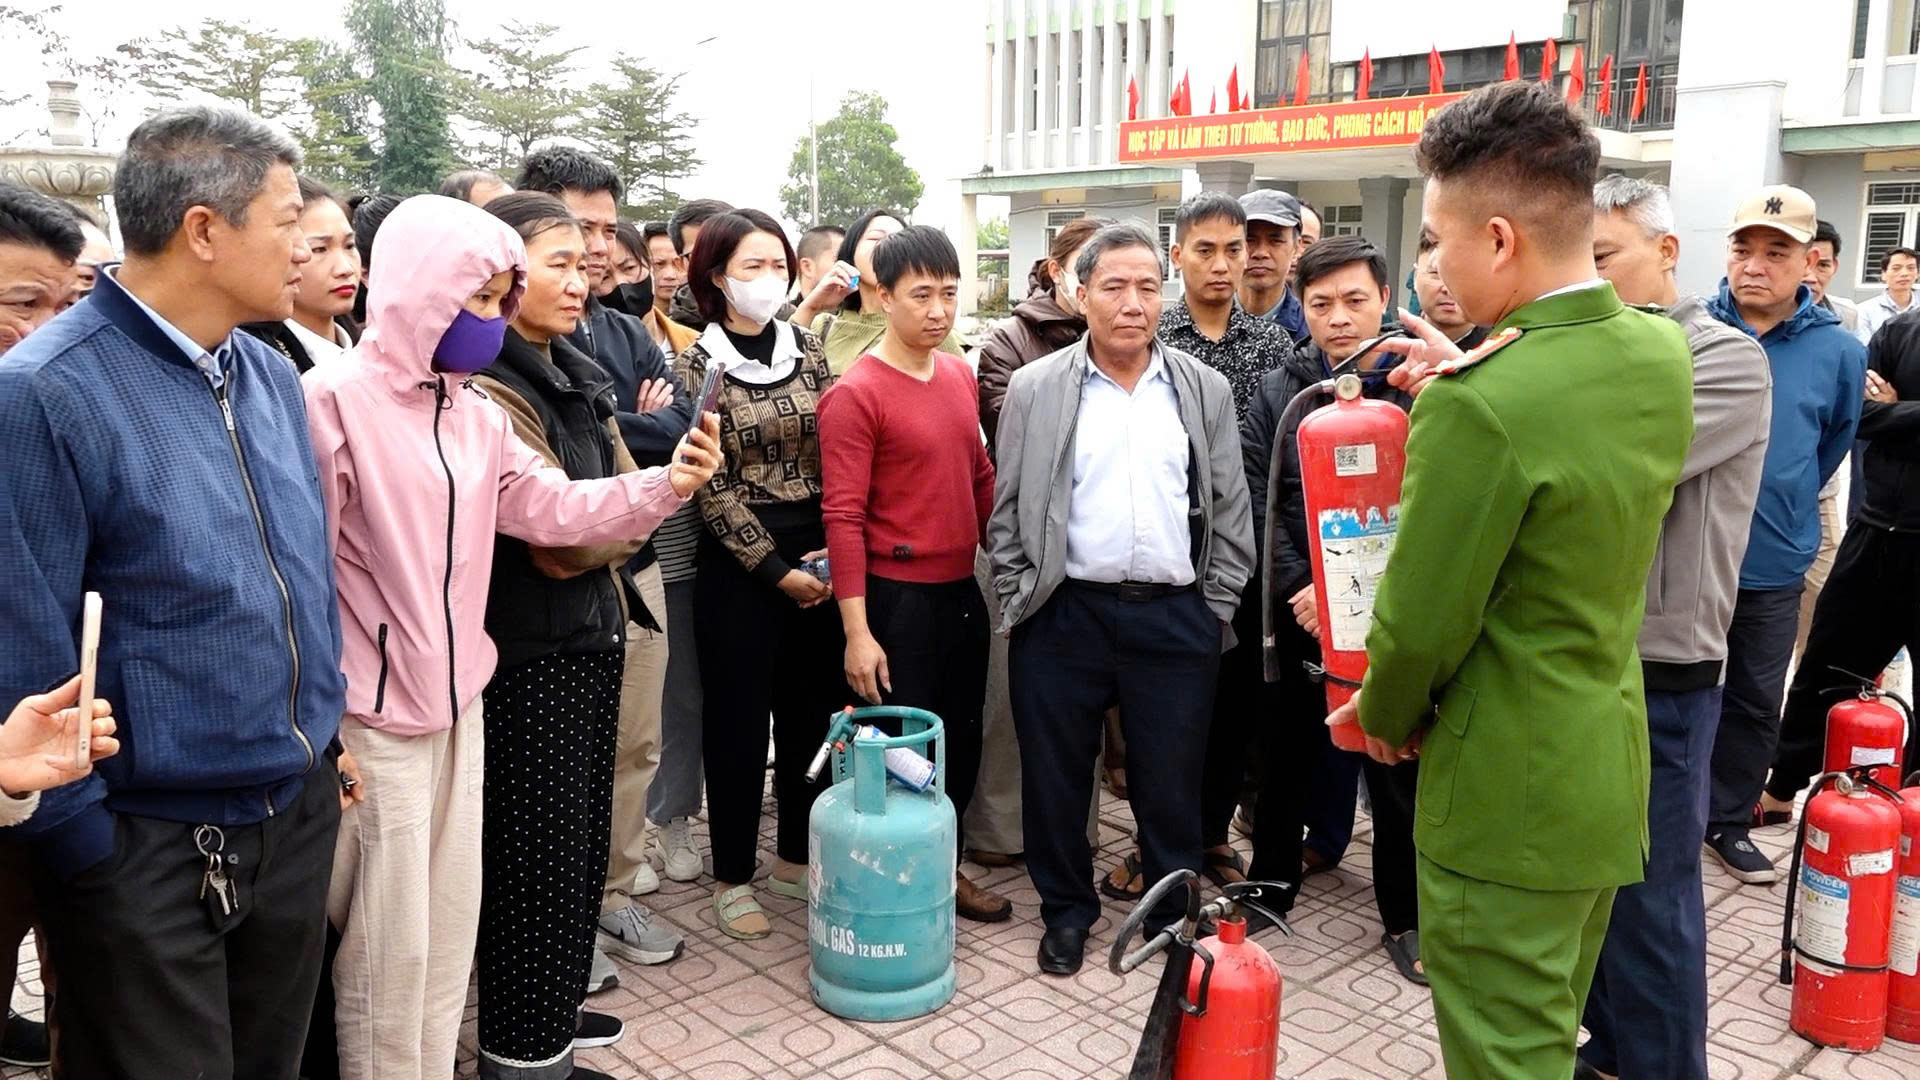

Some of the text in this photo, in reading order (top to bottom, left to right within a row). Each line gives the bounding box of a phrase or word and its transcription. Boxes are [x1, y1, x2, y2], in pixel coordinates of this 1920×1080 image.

[1128, 131, 1147, 157] HỌC
[1148, 125, 1166, 156] TẬP
[1167, 124, 1180, 150] VÀ
[1181, 123, 1202, 149] LÀM
[1204, 124, 1229, 148] THEO
[1333, 112, 1372, 139] PHONG
[1374, 106, 1405, 137] CÁCH
[1407, 101, 1425, 134] HỒ
[1764, 196, 1783, 215] NY
[831, 925, 855, 956] GAS
[858, 943, 869, 957] 12
